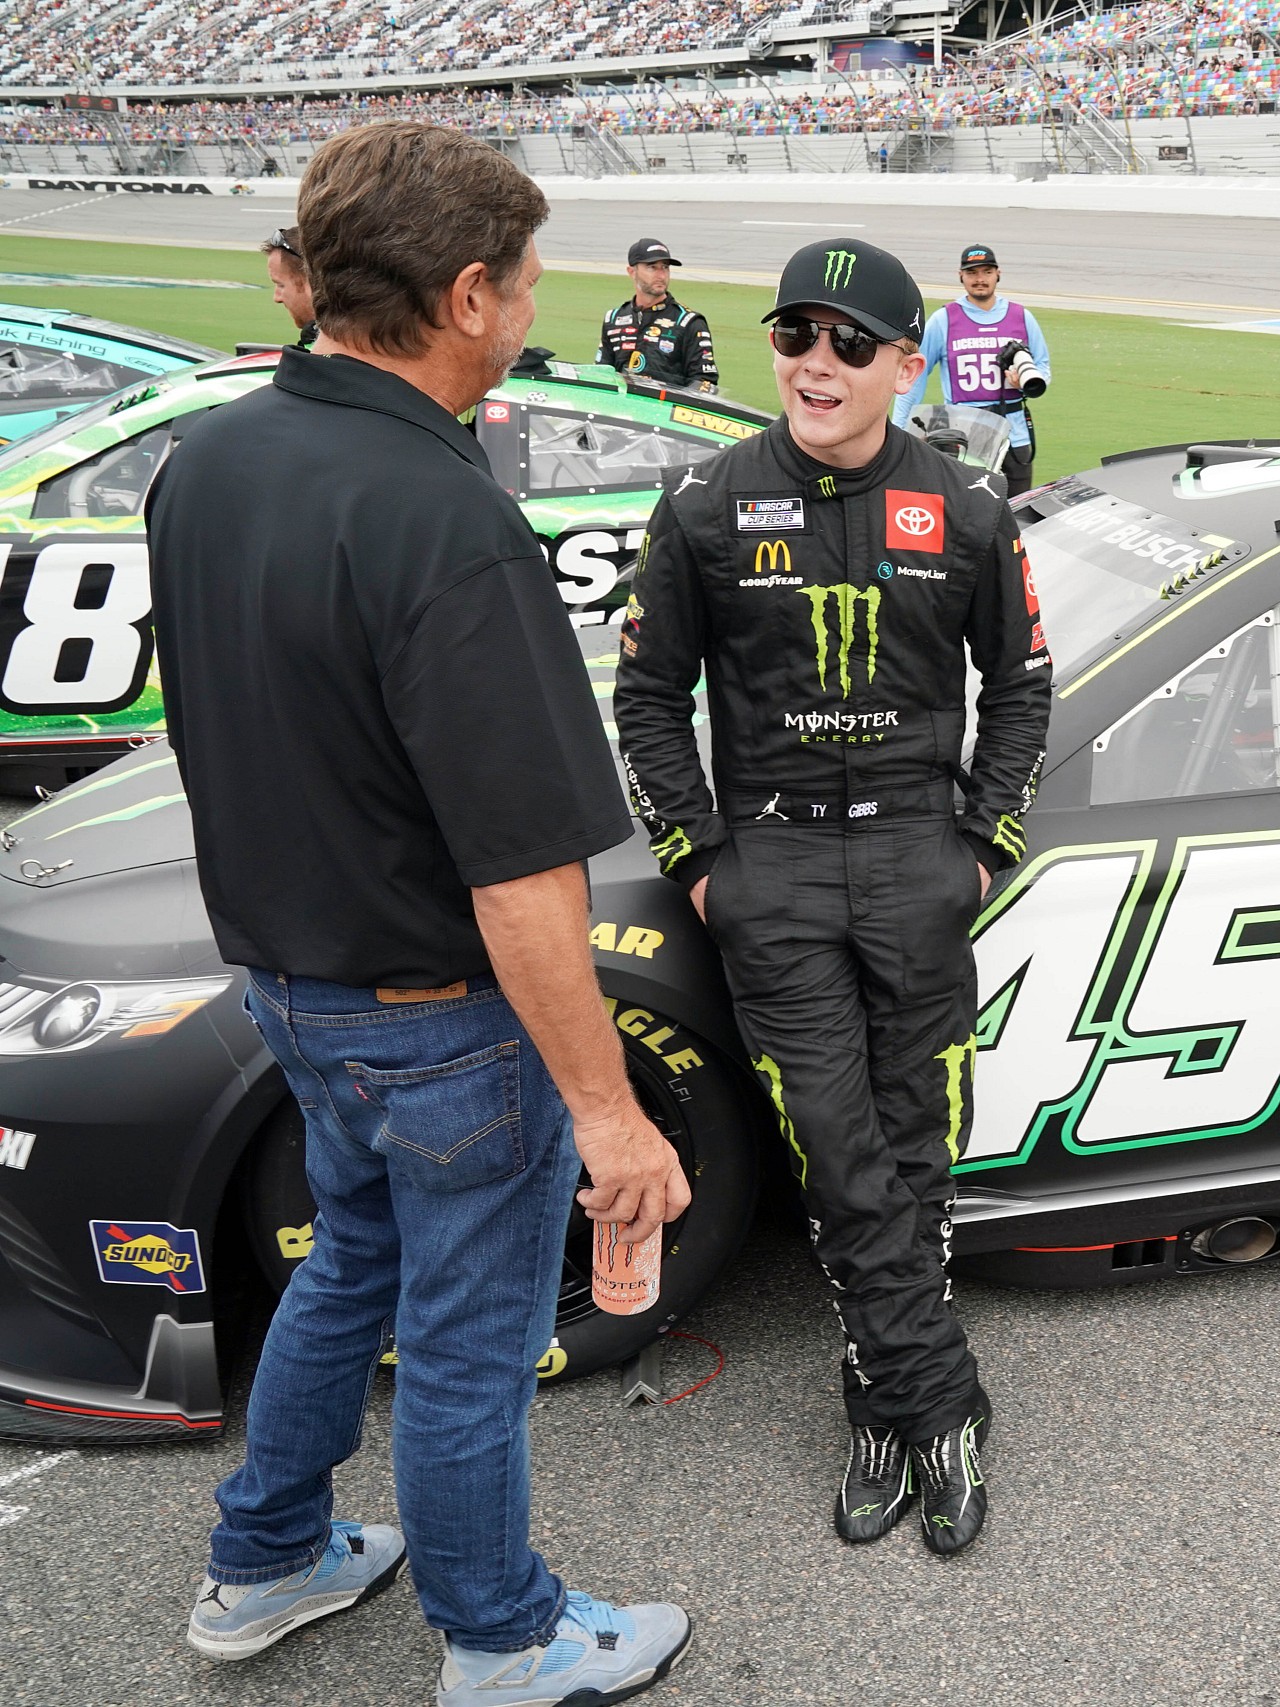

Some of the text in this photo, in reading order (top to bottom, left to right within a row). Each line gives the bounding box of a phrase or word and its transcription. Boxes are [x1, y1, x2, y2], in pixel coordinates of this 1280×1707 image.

[28, 179, 213, 195] DAYTONA
[27, 332, 107, 357] Fishing
[952, 337, 998, 352] LICENSED
[757, 502, 793, 512] NASCAR
[747, 514, 794, 524] CUP SERIES
[897, 566, 947, 580] MoneyLion
[739, 575, 804, 588] GOODYEAR
[784, 710, 899, 732] MONSTER
[801, 733, 884, 744] ENERGY
[811, 801, 878, 819] TY GIBBS
[108, 1246, 188, 1271] SUNOCO
